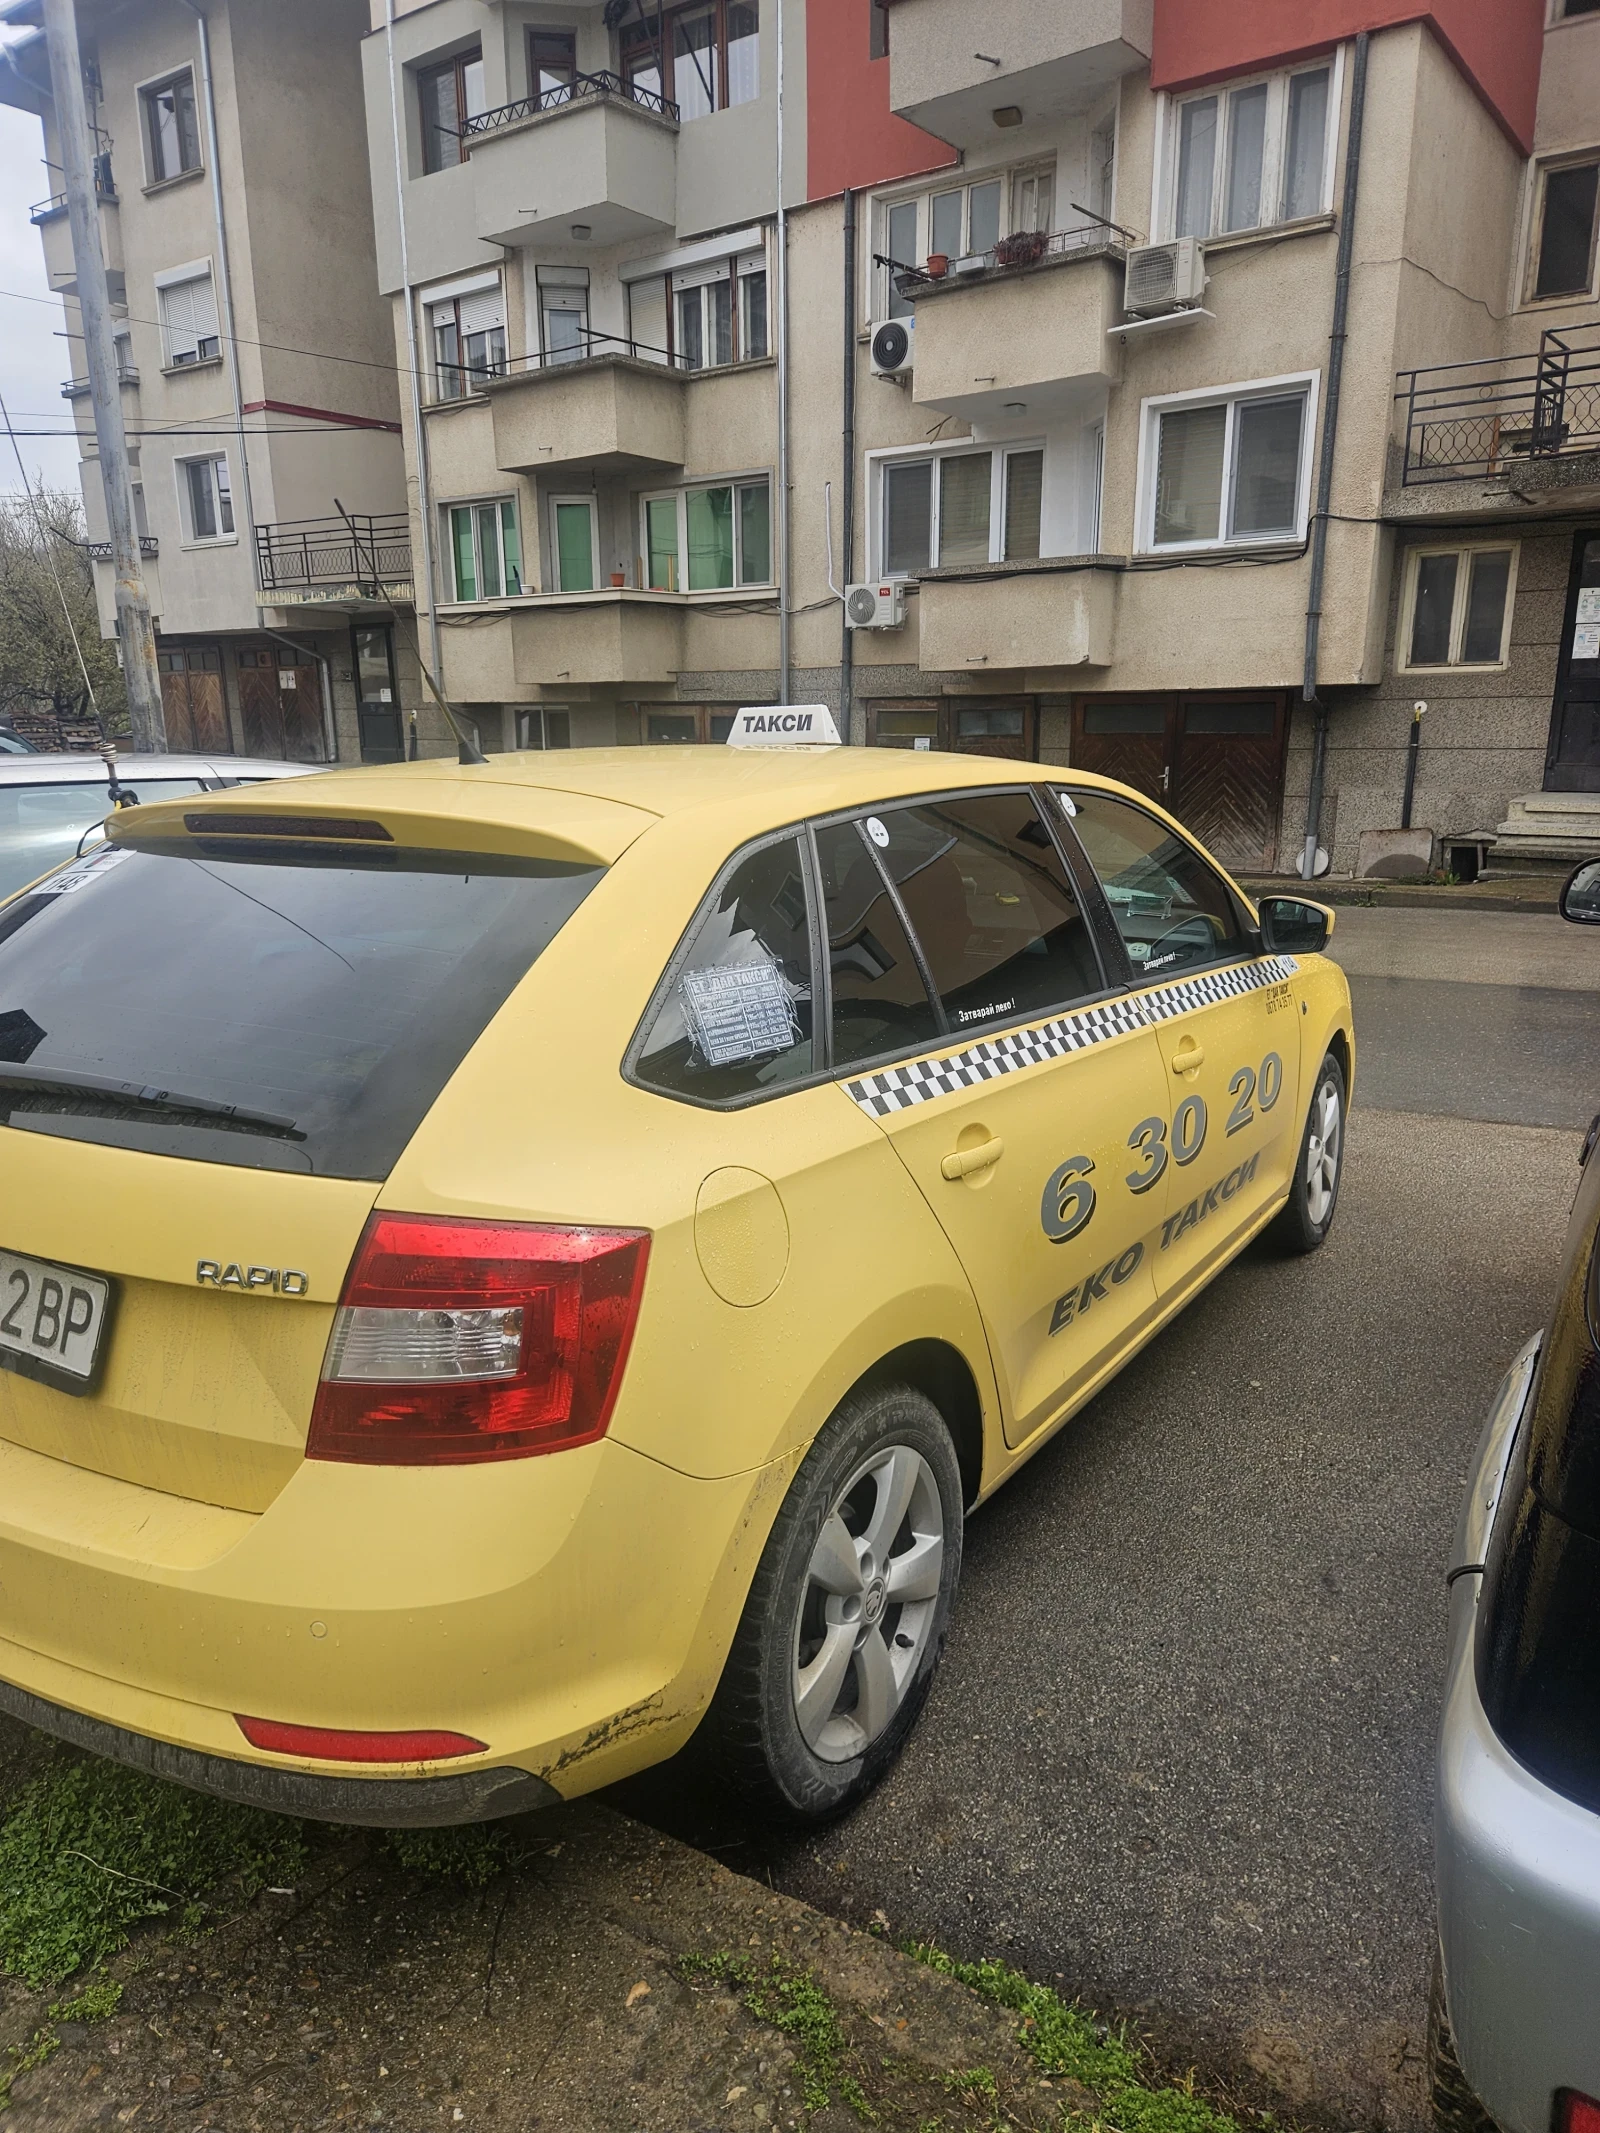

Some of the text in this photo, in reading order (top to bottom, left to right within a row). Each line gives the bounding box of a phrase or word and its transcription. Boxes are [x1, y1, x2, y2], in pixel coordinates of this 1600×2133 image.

[743, 714, 813, 733] ТАКСИ
[959, 1003, 995, 1022] Затварай
[995, 1001, 1012, 1014] леко
[1041, 1051, 1283, 1245] 6 30 20
[1048, 1152, 1261, 1337] ЕКО ТАКСИ
[196, 1259, 310, 1296] RAPID
